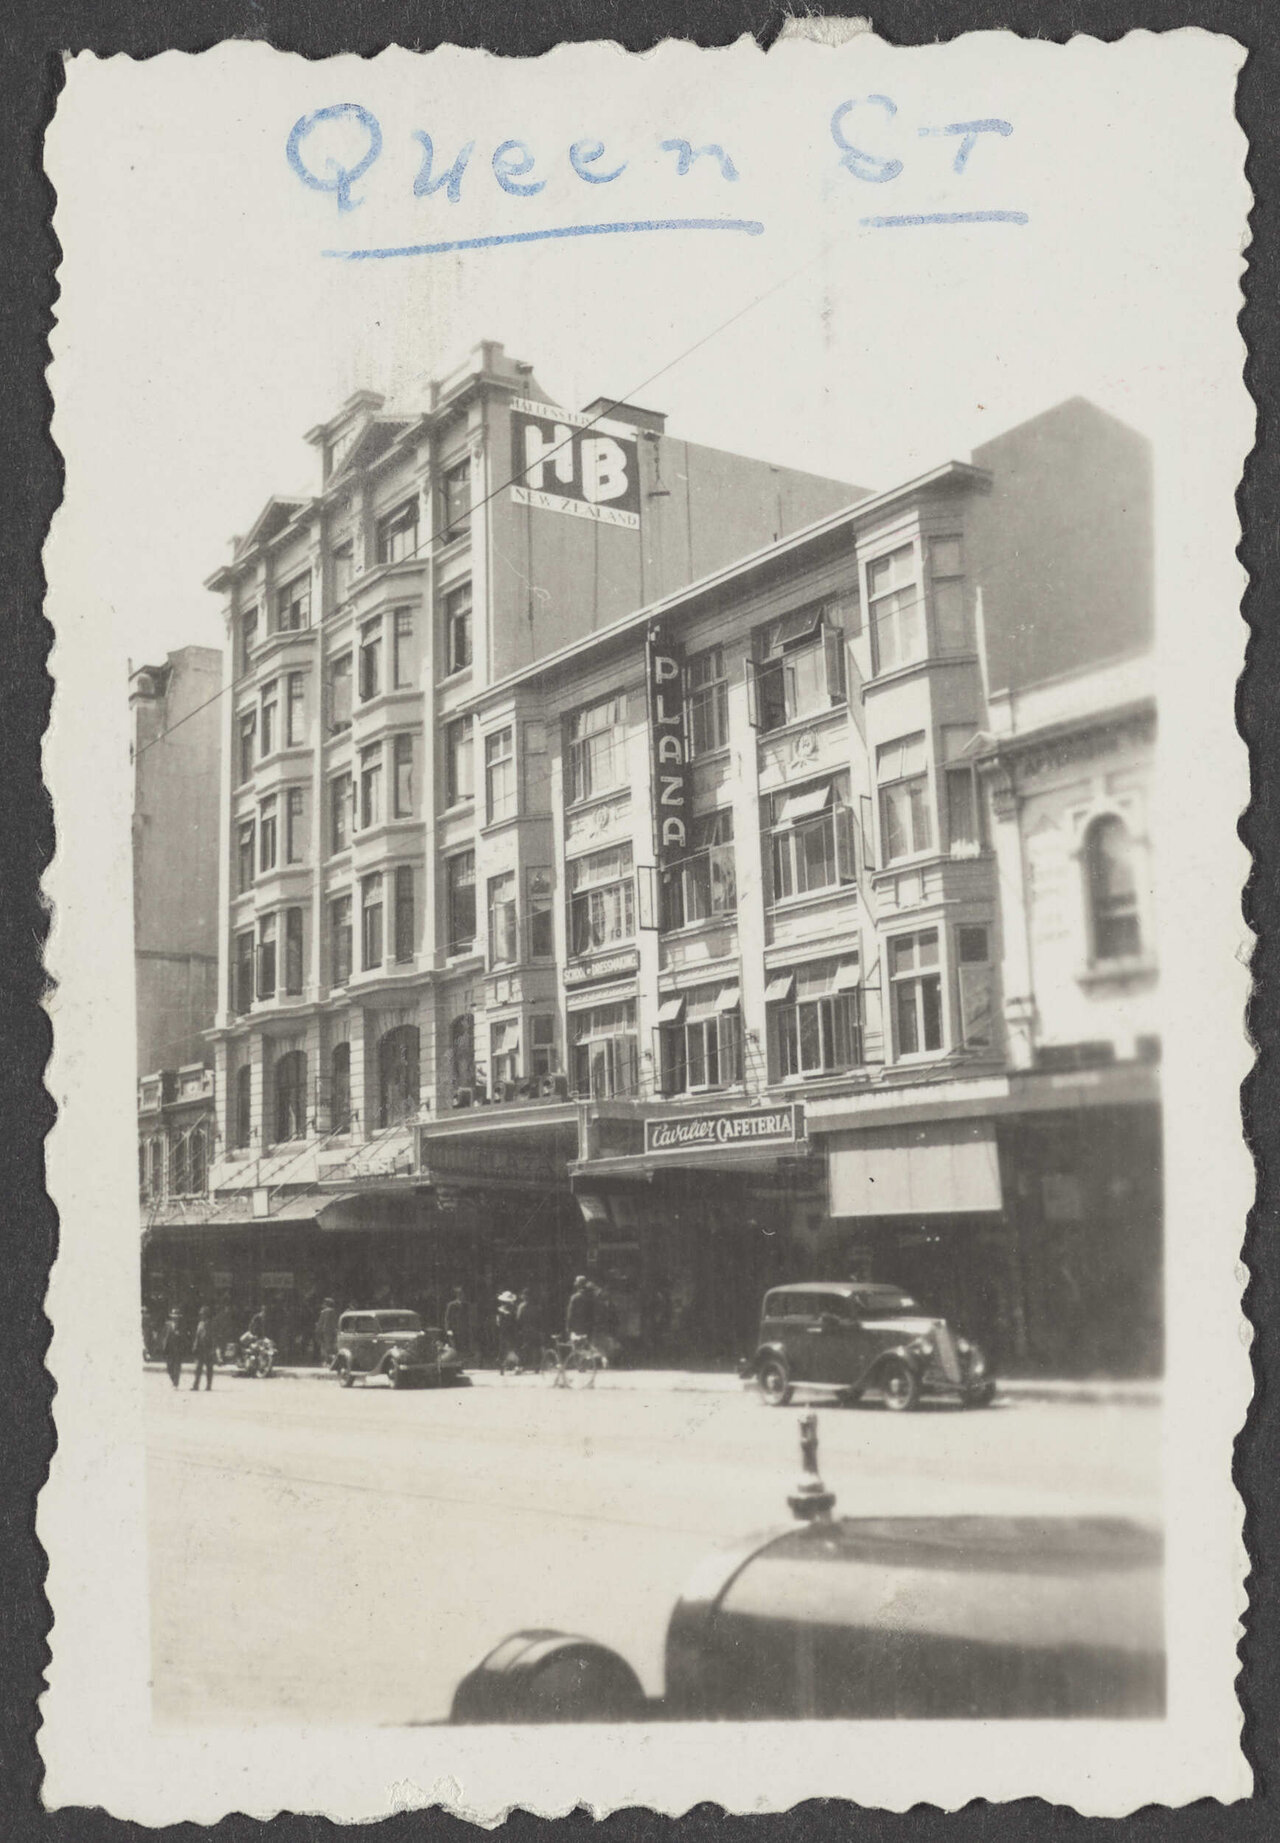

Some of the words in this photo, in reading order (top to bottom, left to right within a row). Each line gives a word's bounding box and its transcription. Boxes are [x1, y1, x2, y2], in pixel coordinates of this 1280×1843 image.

[286, 102, 740, 213] Queen
[525, 424, 628, 503] HB
[515, 488, 550, 506] NEW
[560, 498, 637, 526] ZEALAND
[654, 655, 686, 848] PLAZA
[652, 1119, 716, 1147] Cavalier
[717, 1114, 792, 1142] CAFETERIA
